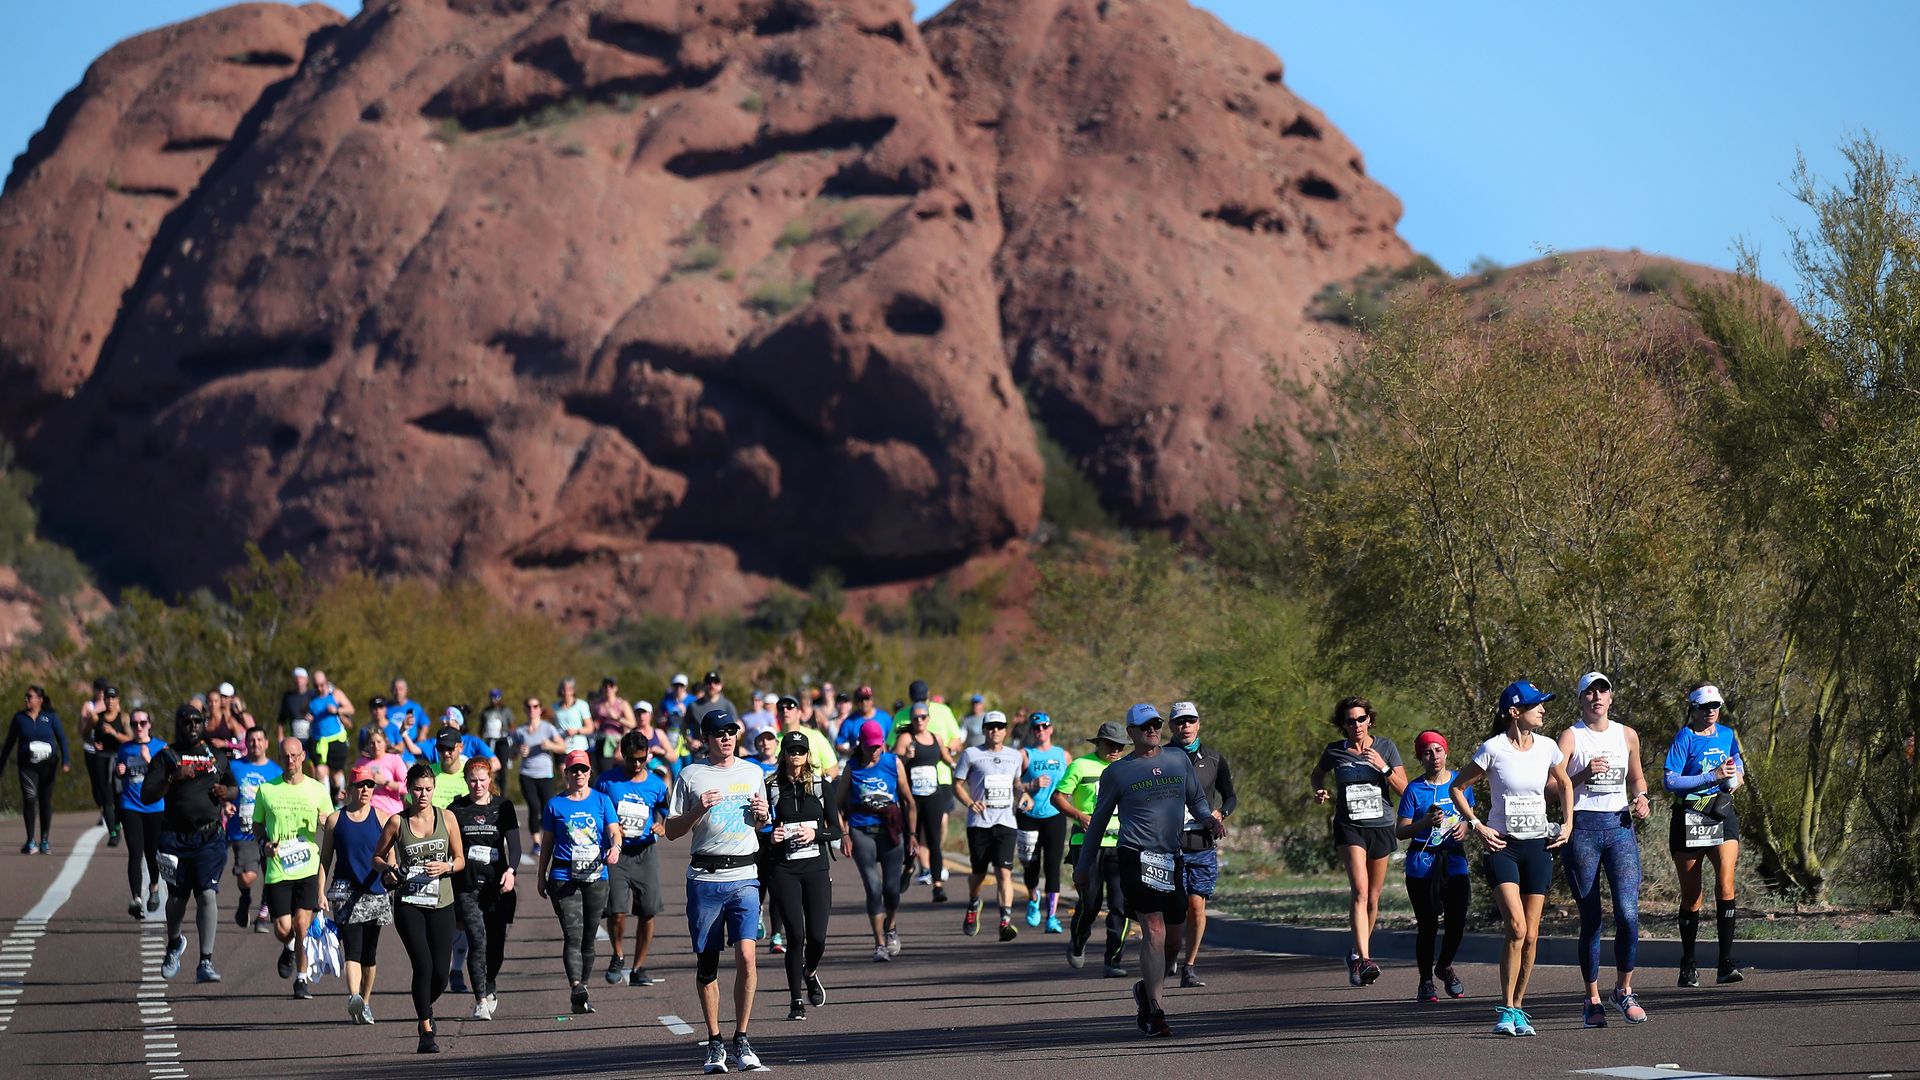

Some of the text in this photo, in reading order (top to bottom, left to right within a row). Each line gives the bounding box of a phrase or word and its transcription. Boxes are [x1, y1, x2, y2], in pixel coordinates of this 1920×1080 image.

[1591, 769, 1621, 780] 652
[1131, 776, 1184, 792] RUN LUCKY
[1351, 799, 1380, 810] 5644
[620, 816, 644, 828] 7378
[1510, 816, 1543, 828] 5203
[405, 841, 446, 857] BUT DID
[283, 848, 310, 866] 11061
[1146, 866, 1169, 881] 4191
[408, 882, 434, 894] 5175
